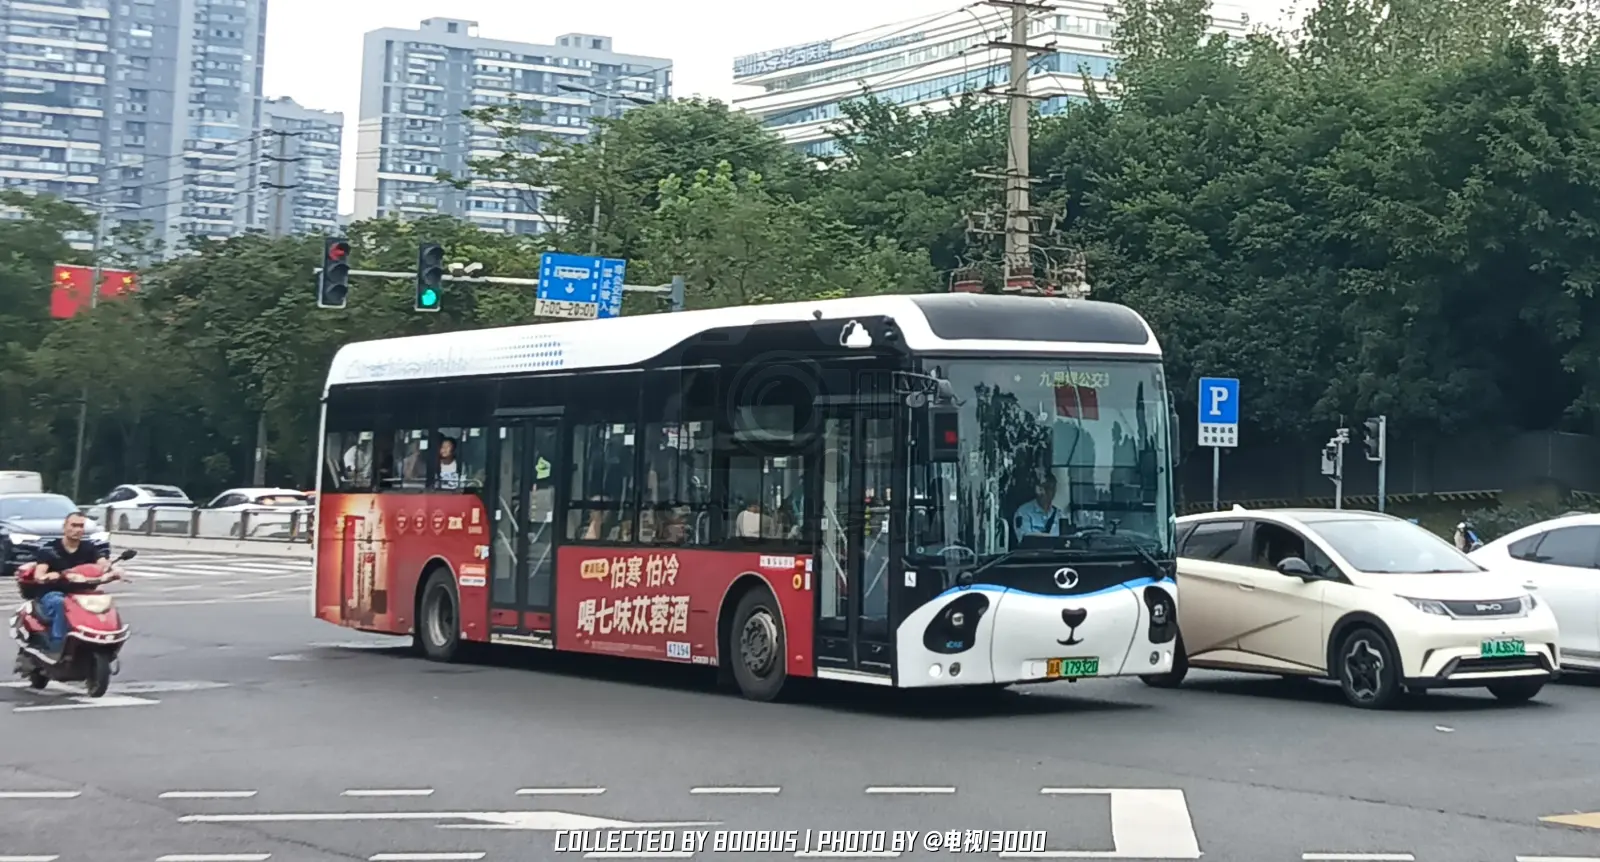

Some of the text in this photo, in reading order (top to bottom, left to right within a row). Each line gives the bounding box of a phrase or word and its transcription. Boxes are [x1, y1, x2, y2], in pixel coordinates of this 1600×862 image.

[1209, 386, 1229, 416] P
[610, 555, 643, 589] 怕寒
[646, 553, 679, 588] 怕冷
[577, 594, 690, 636] 喝七味苁蓉酒
